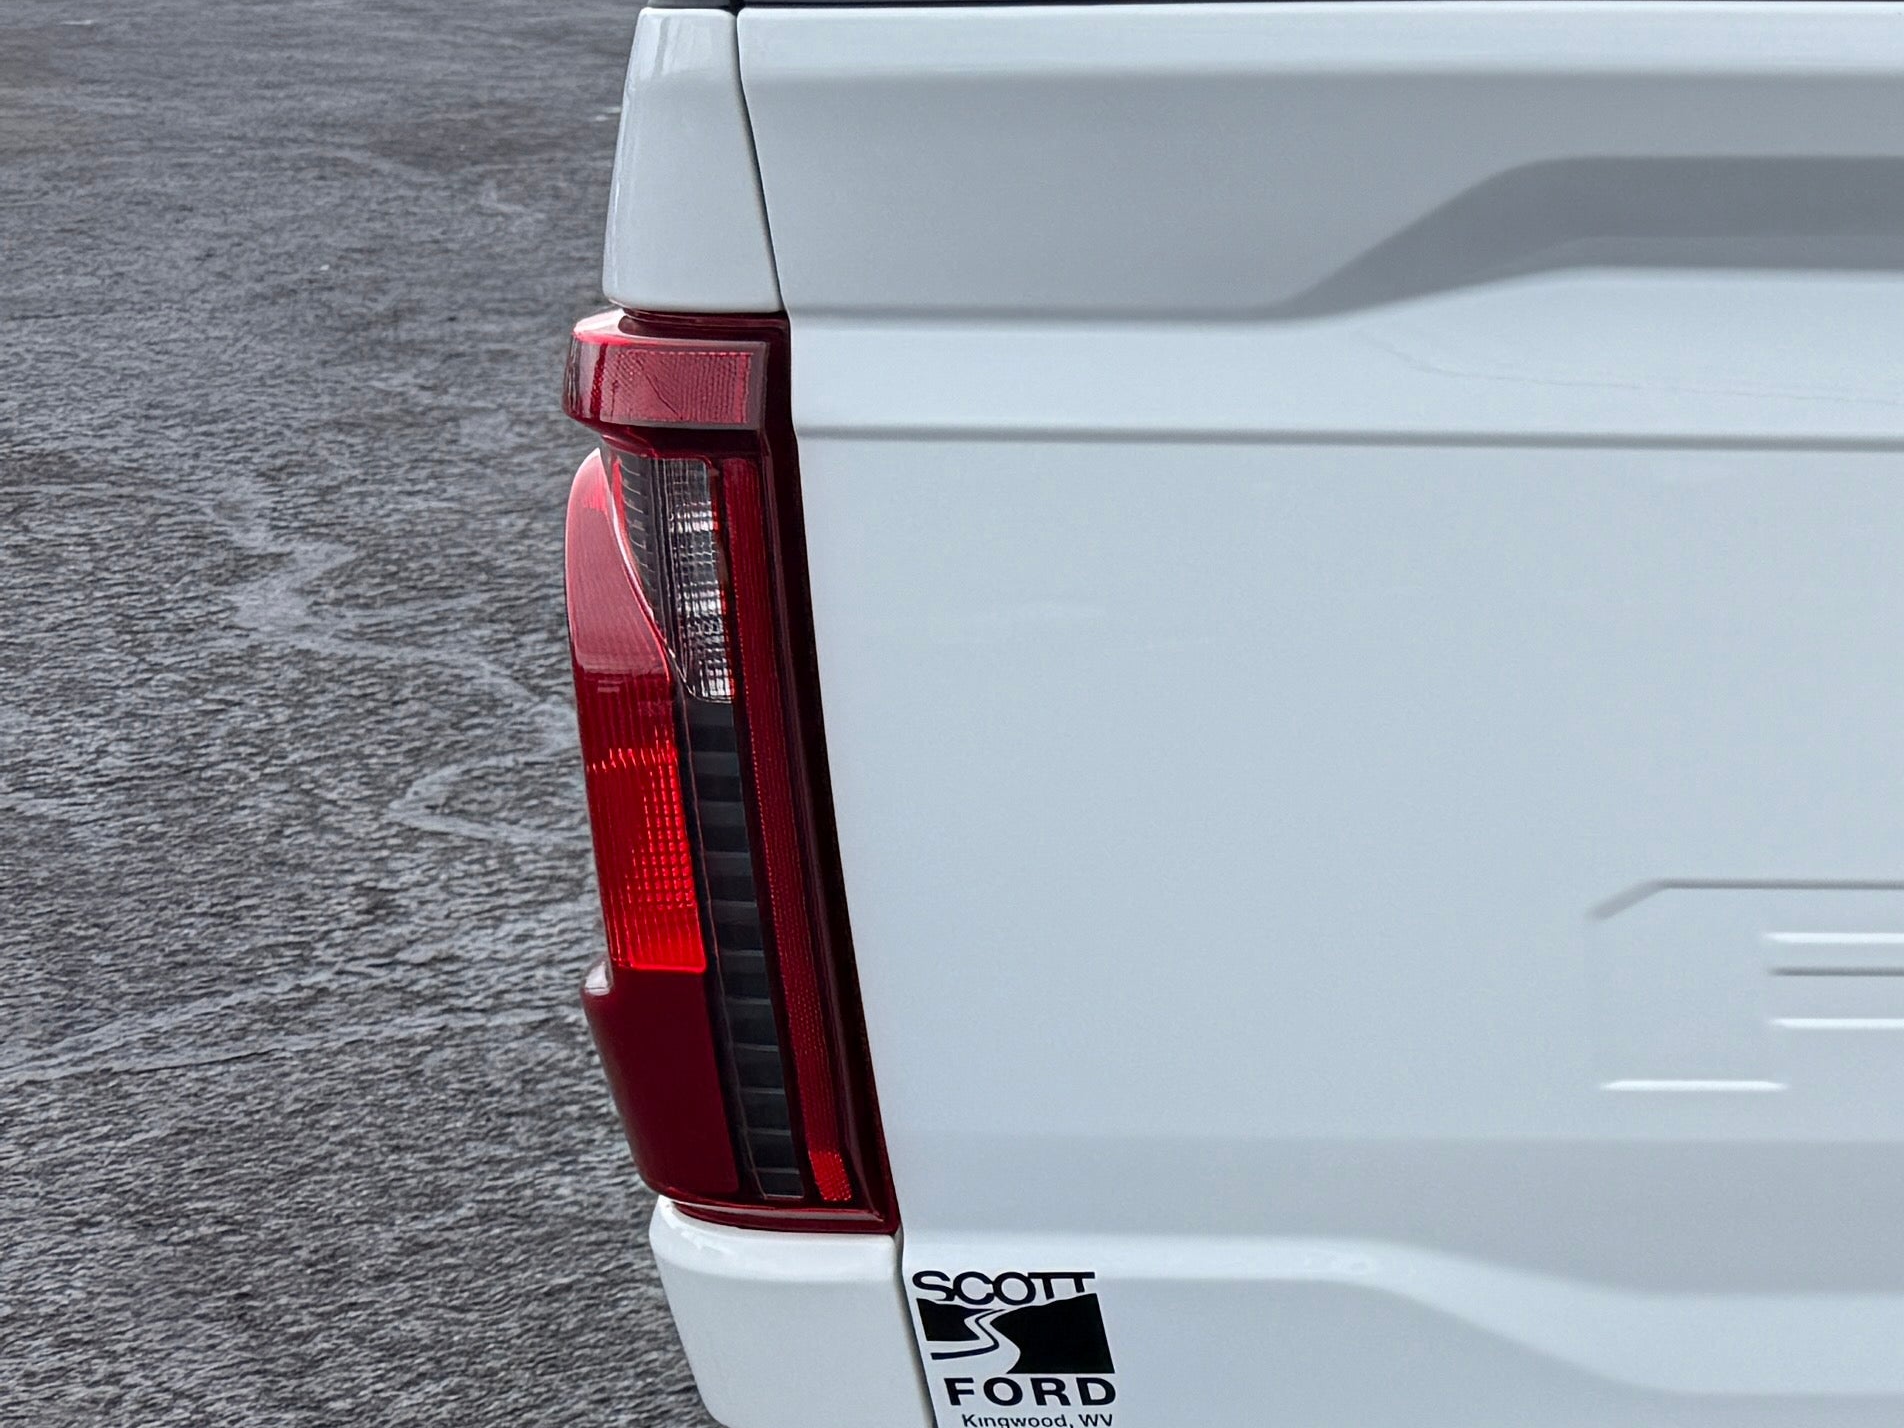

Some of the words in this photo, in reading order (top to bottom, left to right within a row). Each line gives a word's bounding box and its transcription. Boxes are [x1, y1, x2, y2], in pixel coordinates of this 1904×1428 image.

[912, 1269, 1096, 1306] SCOTT
[944, 1376, 1117, 1407] FORD
[1077, 1413, 1113, 1427] WV
